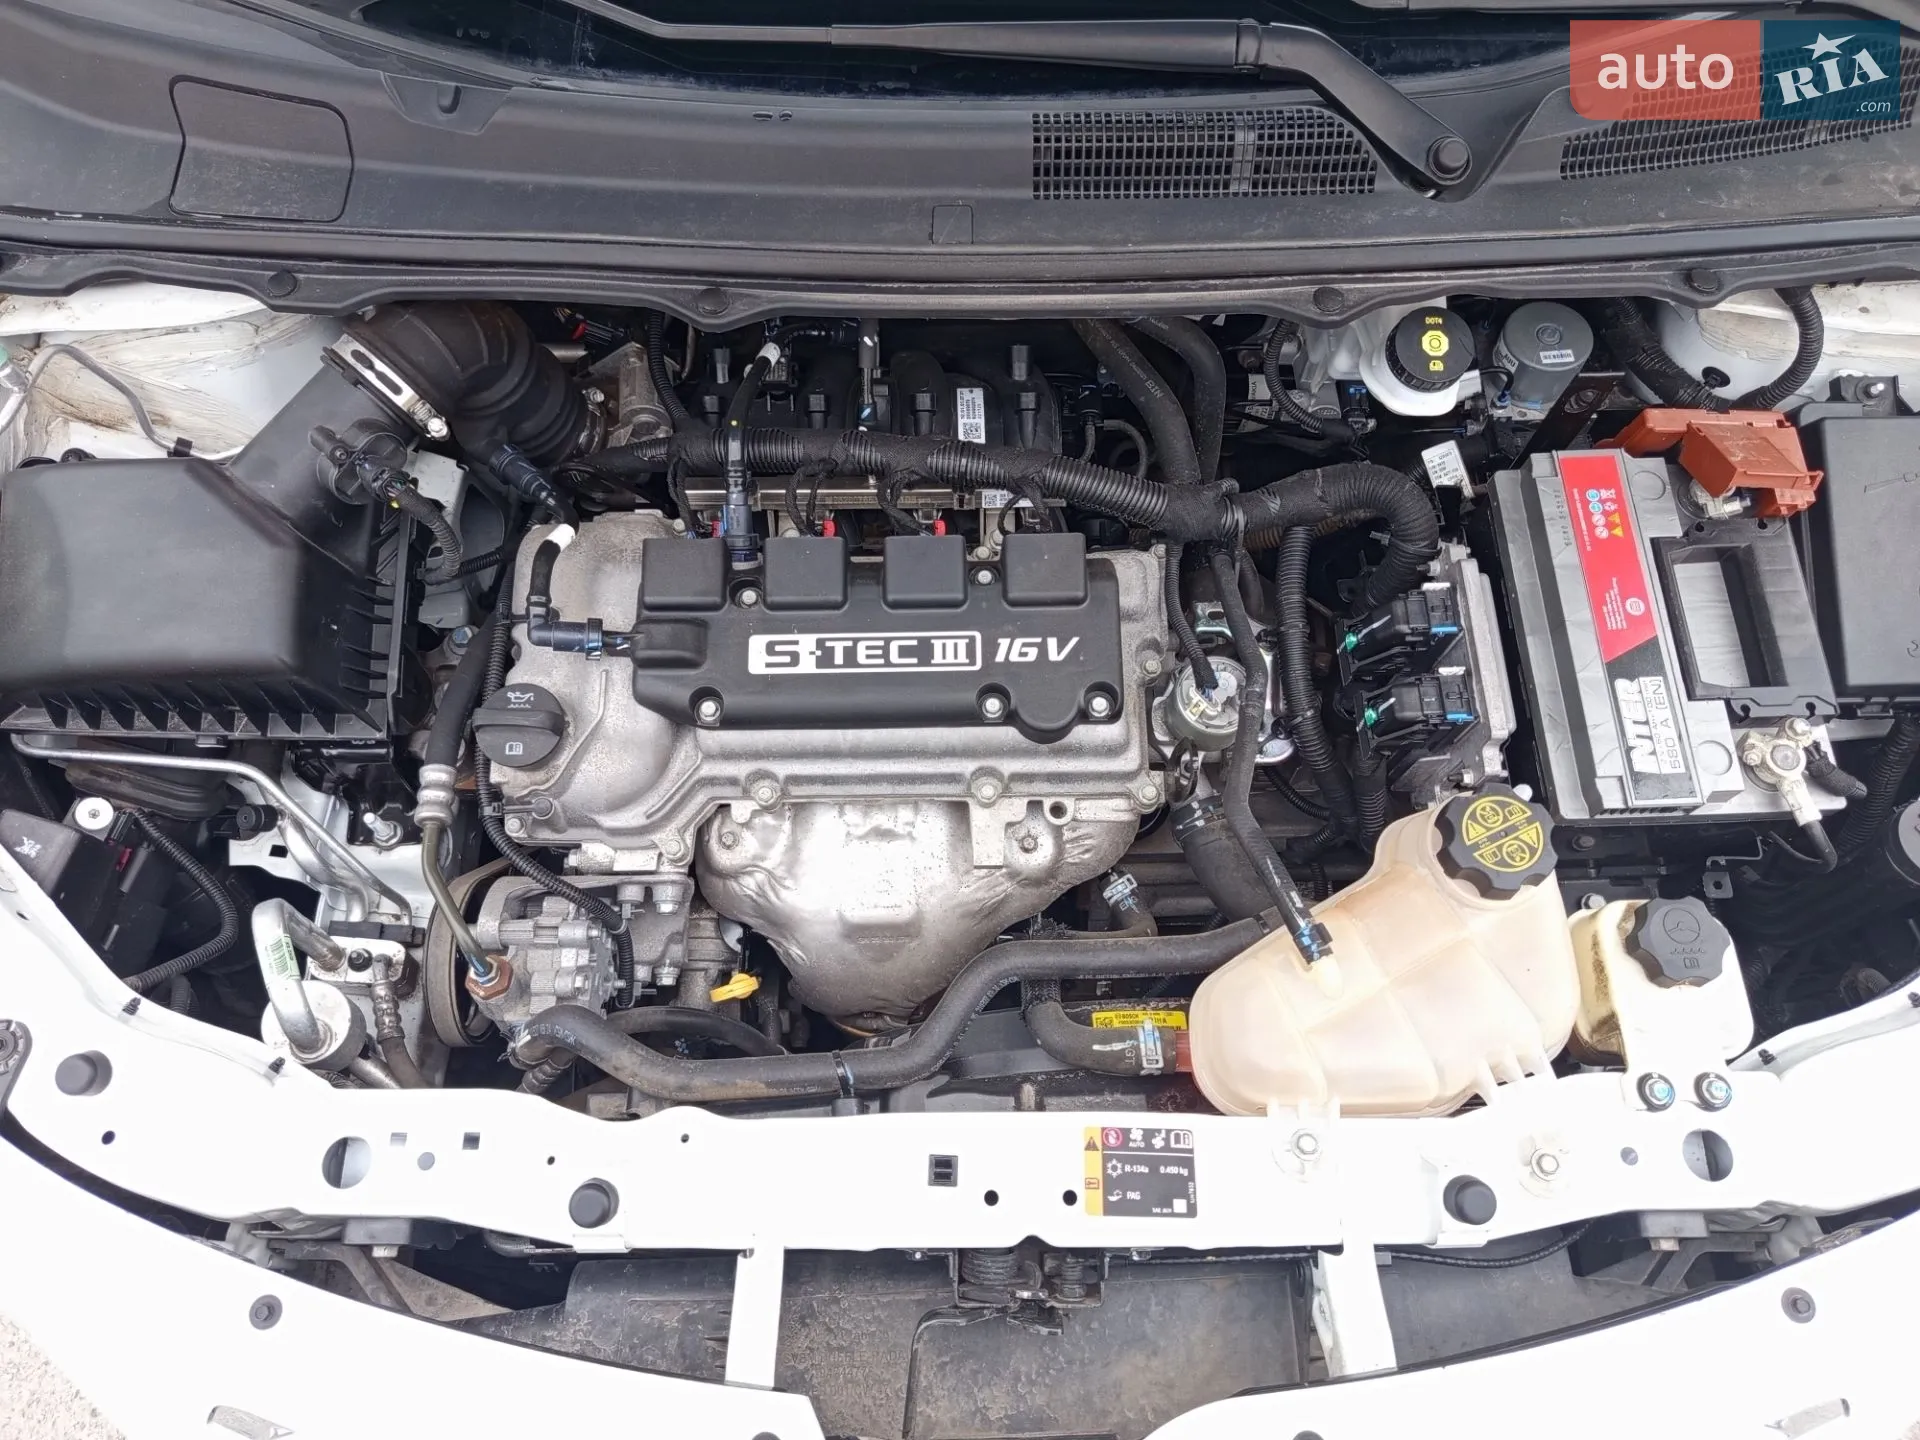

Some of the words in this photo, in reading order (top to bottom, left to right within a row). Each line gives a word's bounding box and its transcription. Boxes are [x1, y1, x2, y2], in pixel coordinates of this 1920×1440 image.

[1425, 316, 1443, 325] DOT4
[764, 638, 918, 668] S-TEC
[930, 638, 969, 664] III
[994, 636, 1080, 663] 16V
[1614, 677, 1662, 775] INTER
[1660, 718, 1672, 729] A
[1664, 737, 1681, 769] 580
[1124, 1163, 1149, 1173] R-134a
[1179, 1166, 1188, 1177] kg
[1126, 1191, 1141, 1200] PAG
